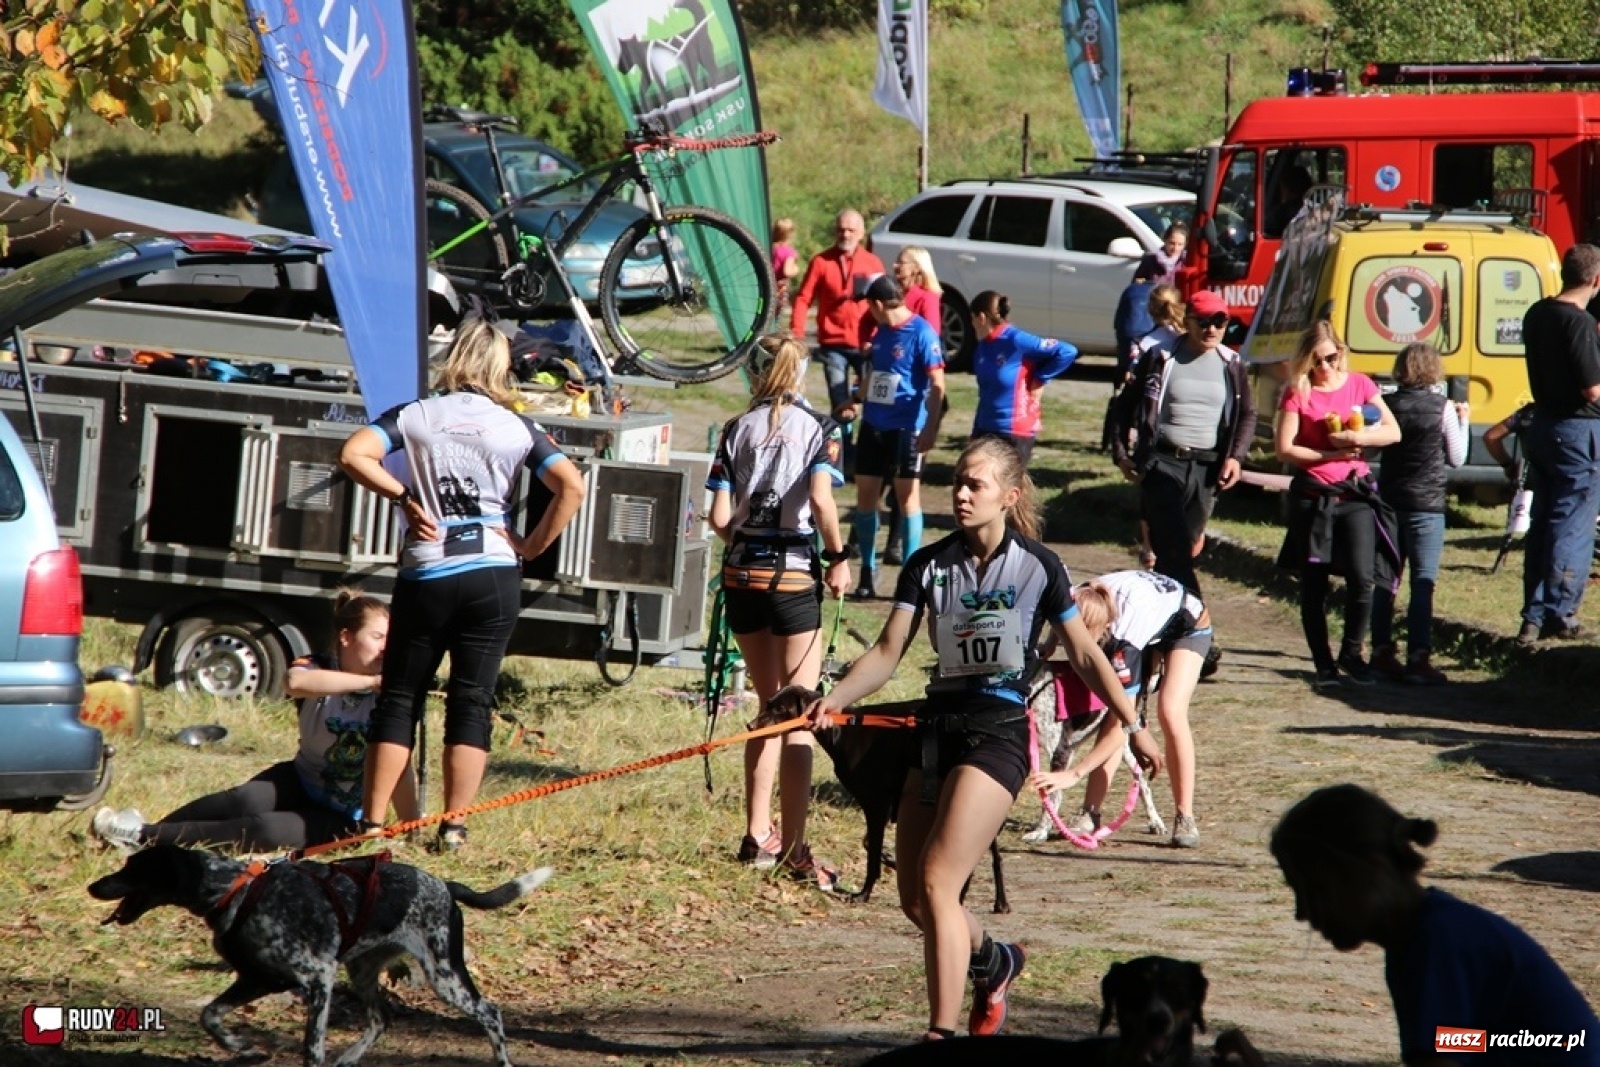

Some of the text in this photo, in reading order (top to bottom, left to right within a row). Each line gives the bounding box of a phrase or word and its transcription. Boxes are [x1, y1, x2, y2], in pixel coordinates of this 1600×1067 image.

[873, 385, 888, 398] 103
[953, 620, 1006, 634] datasport.pl
[957, 637, 1001, 664] 107
